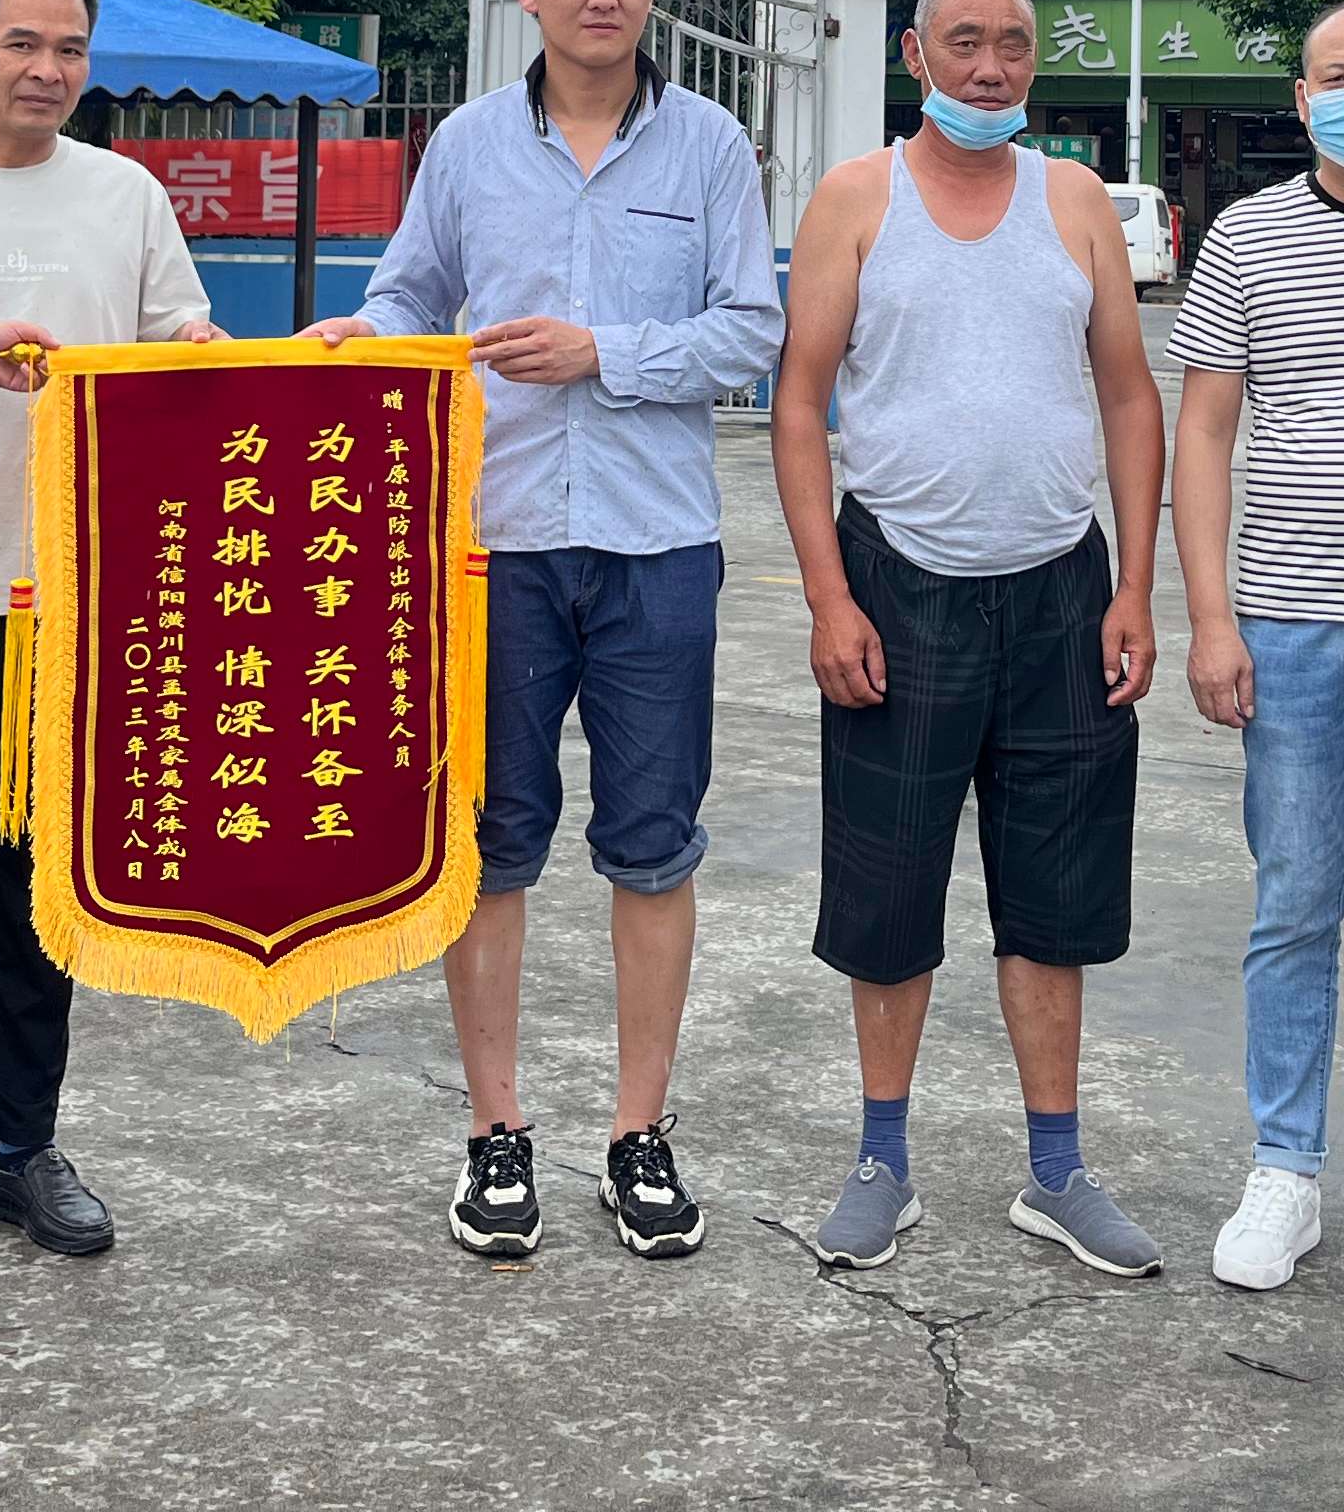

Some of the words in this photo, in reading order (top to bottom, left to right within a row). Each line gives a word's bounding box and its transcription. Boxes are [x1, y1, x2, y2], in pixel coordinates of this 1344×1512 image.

[210, 423, 275, 844] 为民排忧情深似海
[301, 422, 364, 841] 为民办事关怀备至
